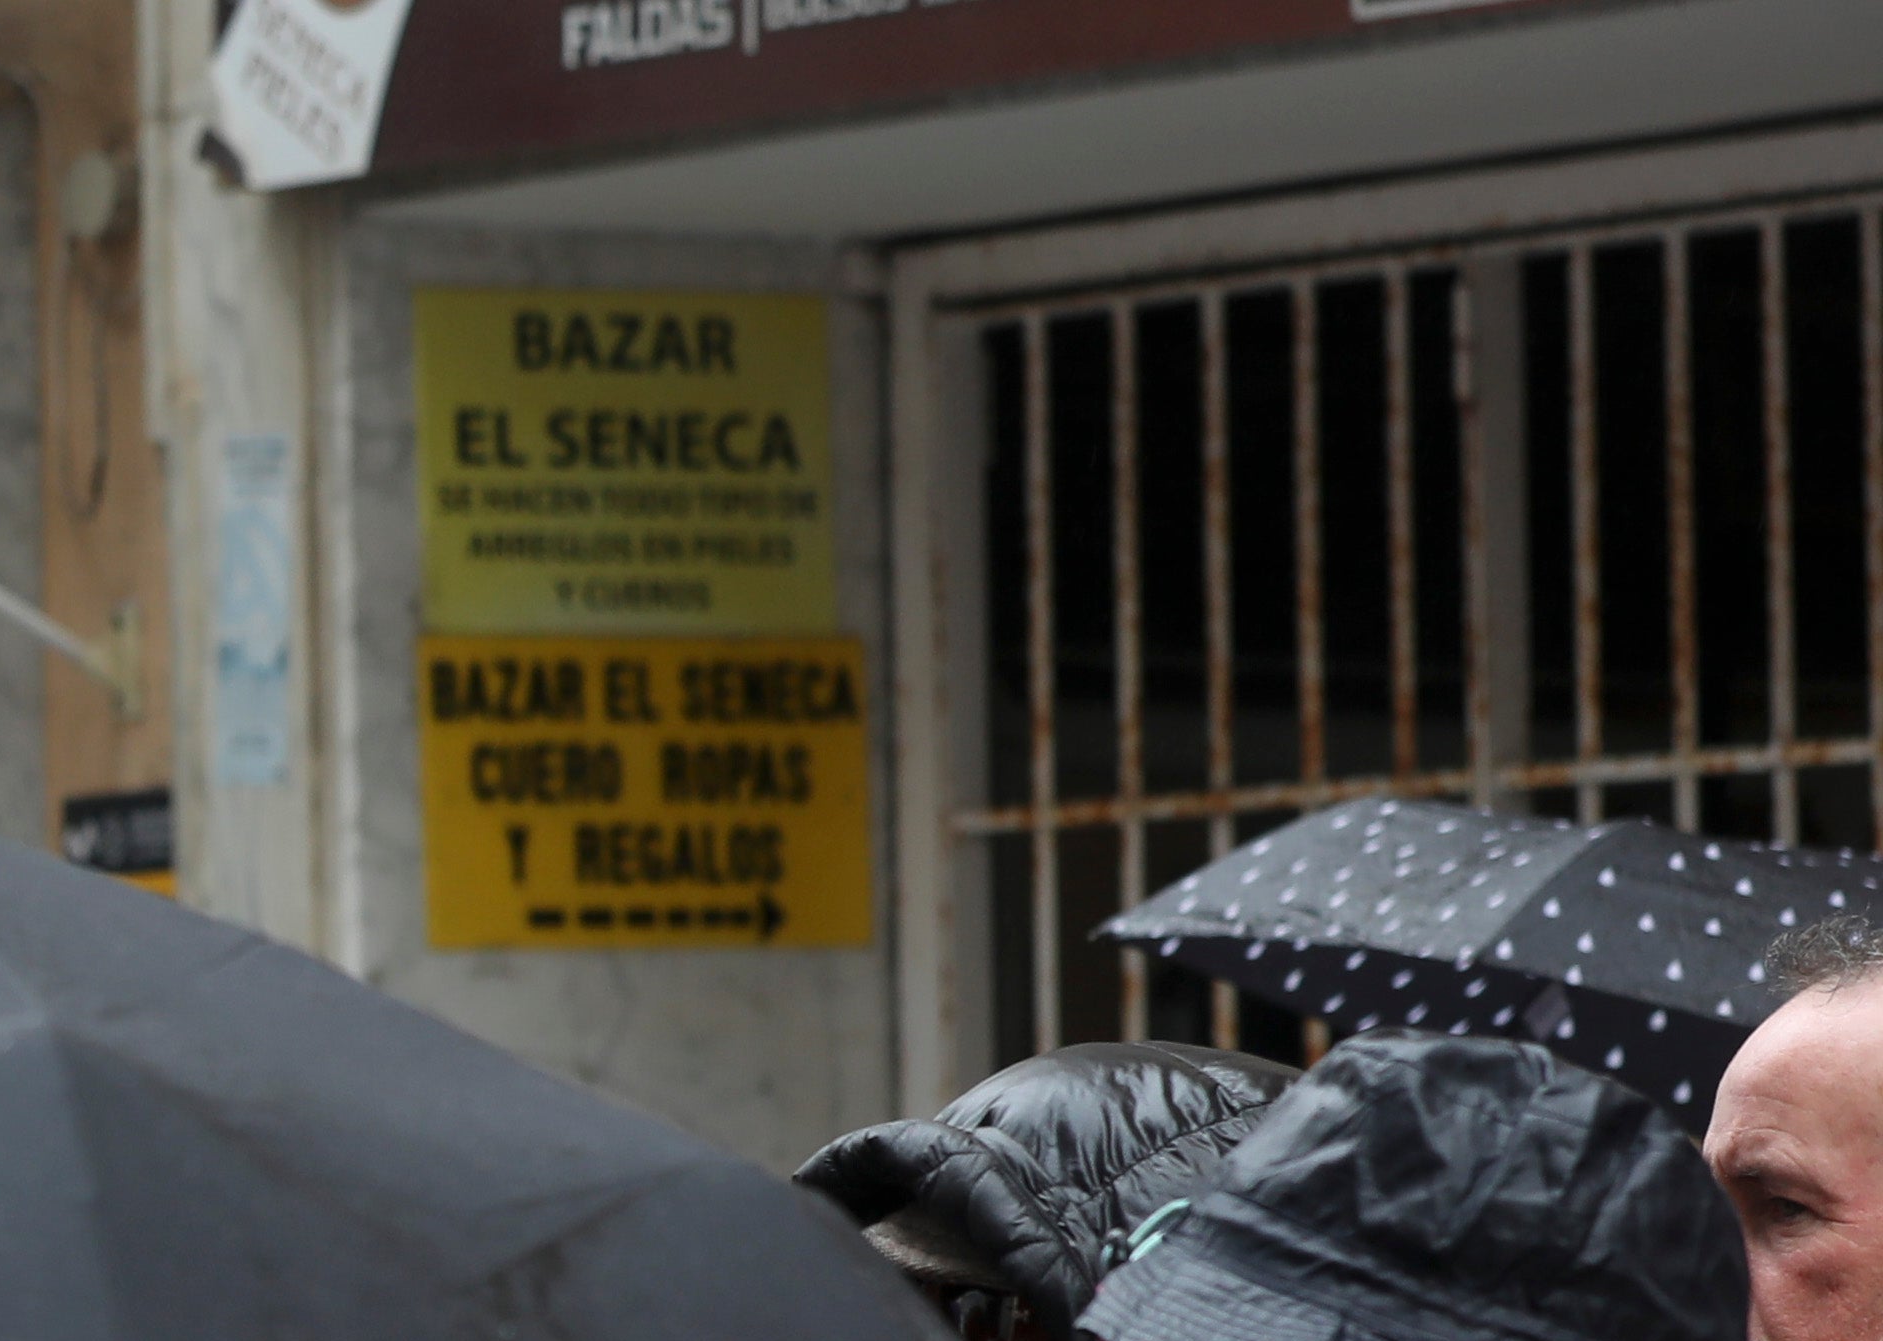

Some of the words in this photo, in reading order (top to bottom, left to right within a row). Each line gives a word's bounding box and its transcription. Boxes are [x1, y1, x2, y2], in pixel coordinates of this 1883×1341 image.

[561, 0, 735, 71] FALDAS
[512, 312, 738, 373] BAZAR
[453, 408, 526, 468] EL
[547, 408, 800, 471] SENECA
[430, 660, 585, 722] BAZAR
[605, 660, 659, 722] EL
[681, 660, 858, 723] SENECA
[470, 744, 622, 803] CUERO
[661, 745, 812, 804] ROPAS
[505, 826, 530, 885] Y
[575, 826, 785, 885] REGALOS
